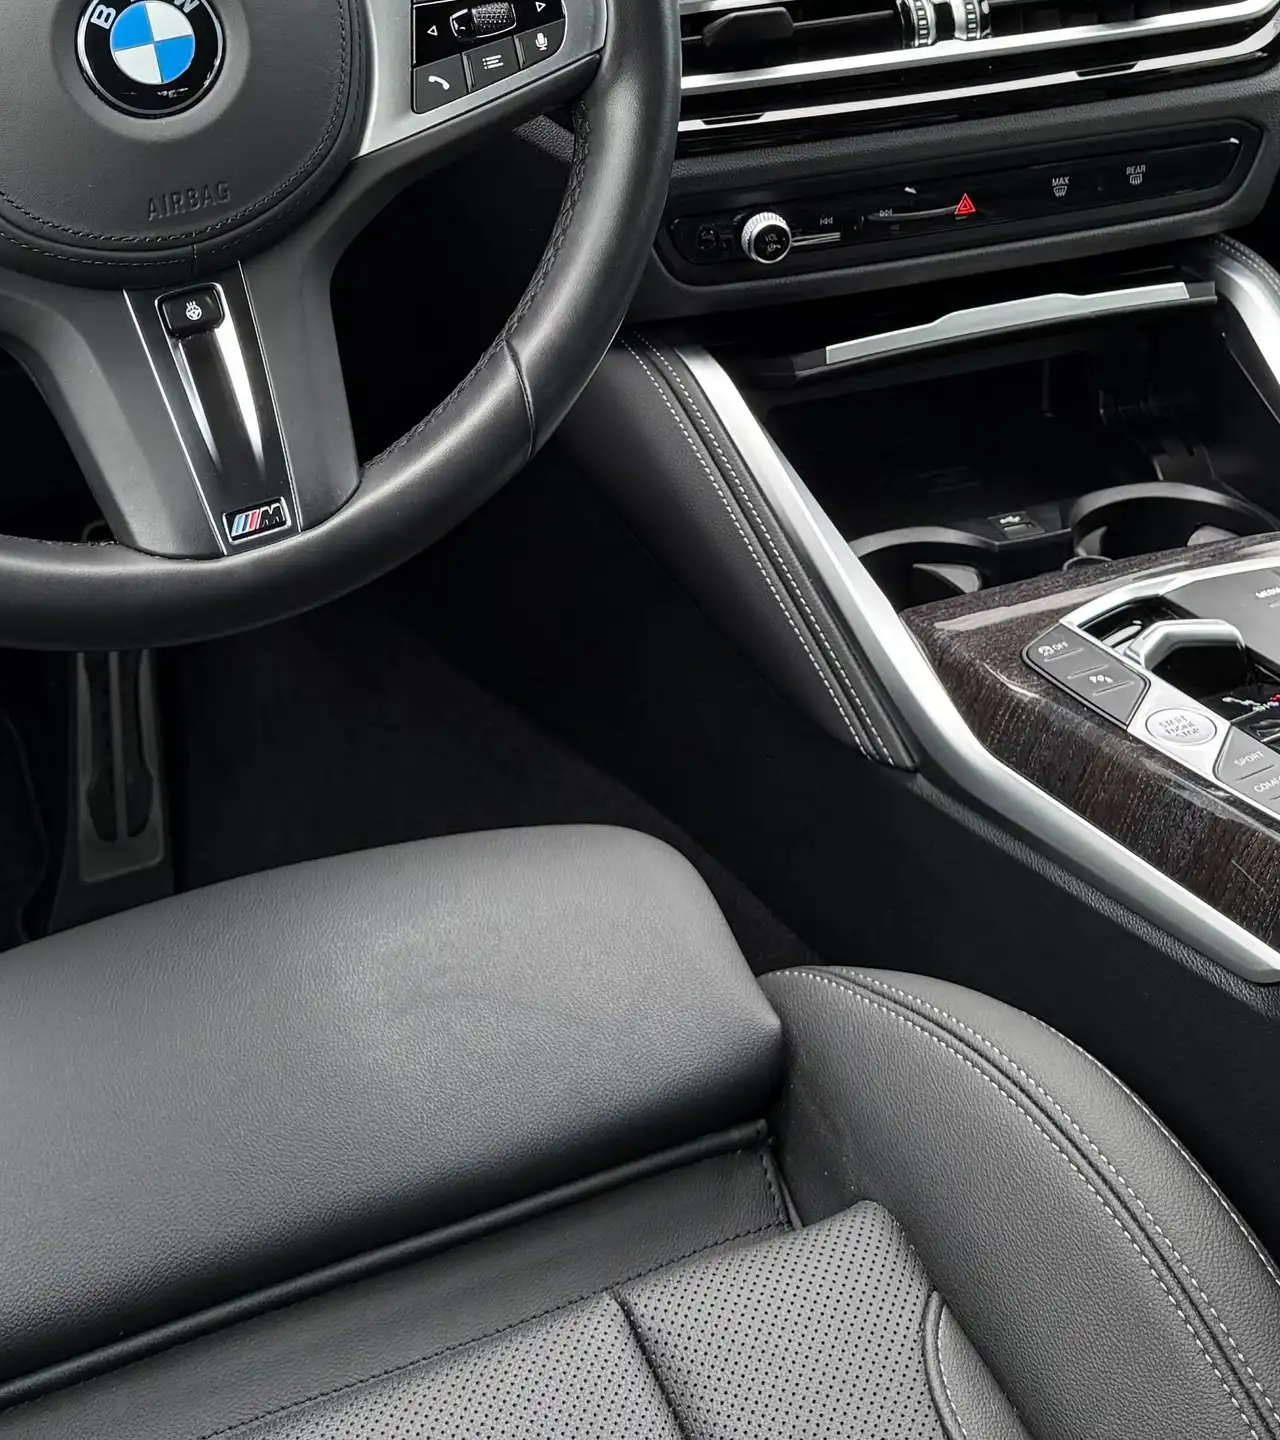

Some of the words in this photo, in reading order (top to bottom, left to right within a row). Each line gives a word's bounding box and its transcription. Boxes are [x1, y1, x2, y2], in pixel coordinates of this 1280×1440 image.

[1126, 164, 1146, 175] REAR
[1052, 176, 1070, 187] MAX
[147, 180, 231, 222] AIRBAG
[1234, 750, 1265, 767] SPORT
